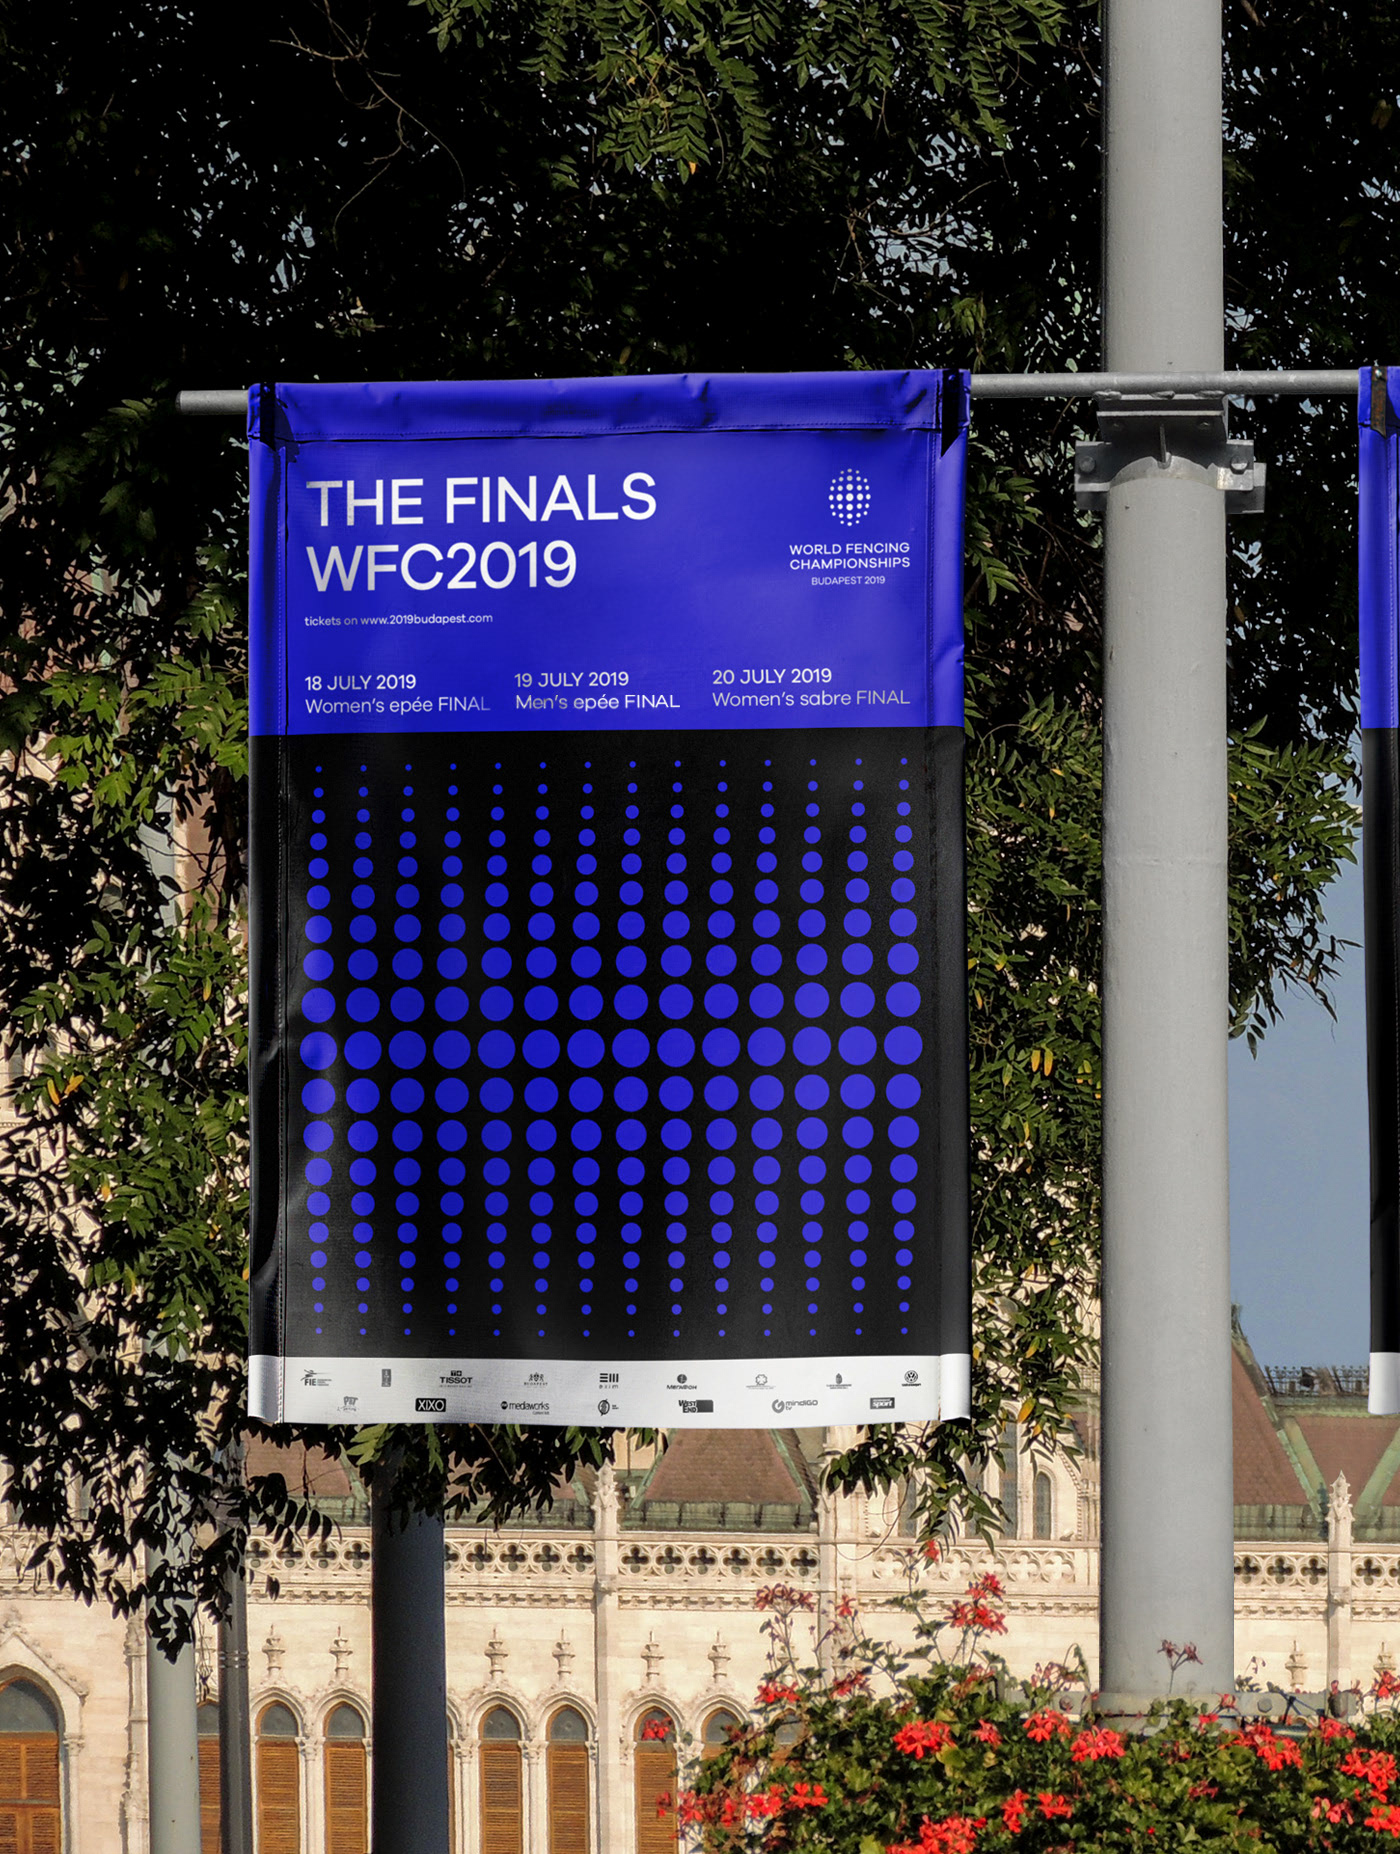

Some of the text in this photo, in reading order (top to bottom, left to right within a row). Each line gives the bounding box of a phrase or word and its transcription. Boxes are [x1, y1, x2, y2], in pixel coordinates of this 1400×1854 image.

[307, 472, 656, 526] THE FINALS
[789, 542, 909, 556] WORLD FENCING
[307, 540, 576, 591] WFC2019
[790, 557, 910, 570] CHAMPIONSHIPS
[811, 575, 886, 586] BUDAPEST 2019
[304, 613, 493, 627] tickets on www.2019budapest.com
[305, 674, 416, 690] 18 JULY 2019
[515, 672, 629, 687] 19 JULY 2019
[713, 668, 831, 684] 20 JULY 2019
[574, 694, 619, 711] epée
[625, 695, 680, 708] FINAL
[800, 690, 851, 706] sabre
[857, 690, 910, 704] FINAL
[390, 697, 433, 715] epée
[439, 697, 489, 711] FINAL
[417, 1399, 445, 1411] XIXO
[508, 1400, 550, 1410] mediaworks
[678, 1399, 697, 1407] WEST
[872, 1400, 893, 1408] sport
